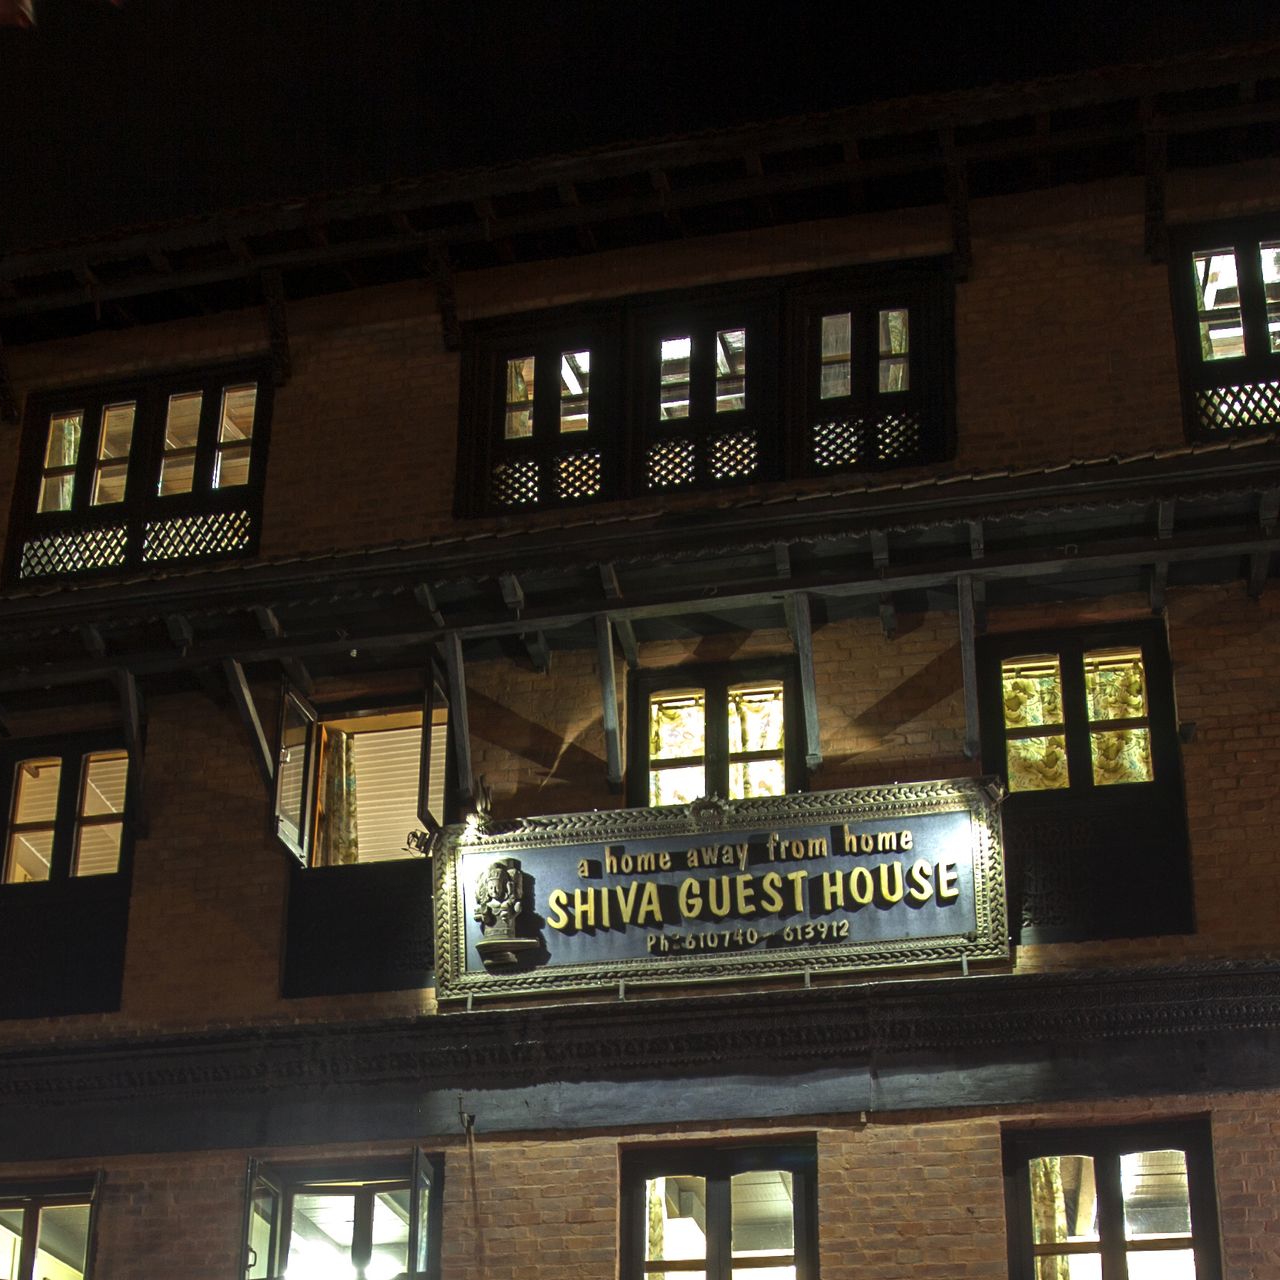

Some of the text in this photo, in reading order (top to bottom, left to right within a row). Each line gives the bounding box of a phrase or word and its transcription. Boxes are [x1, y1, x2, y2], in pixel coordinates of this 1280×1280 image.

[577, 824, 914, 878] a home away from home
[547, 858, 959, 930] SHIVA GUEST HOUSE
[783, 919, 850, 943] 613912
